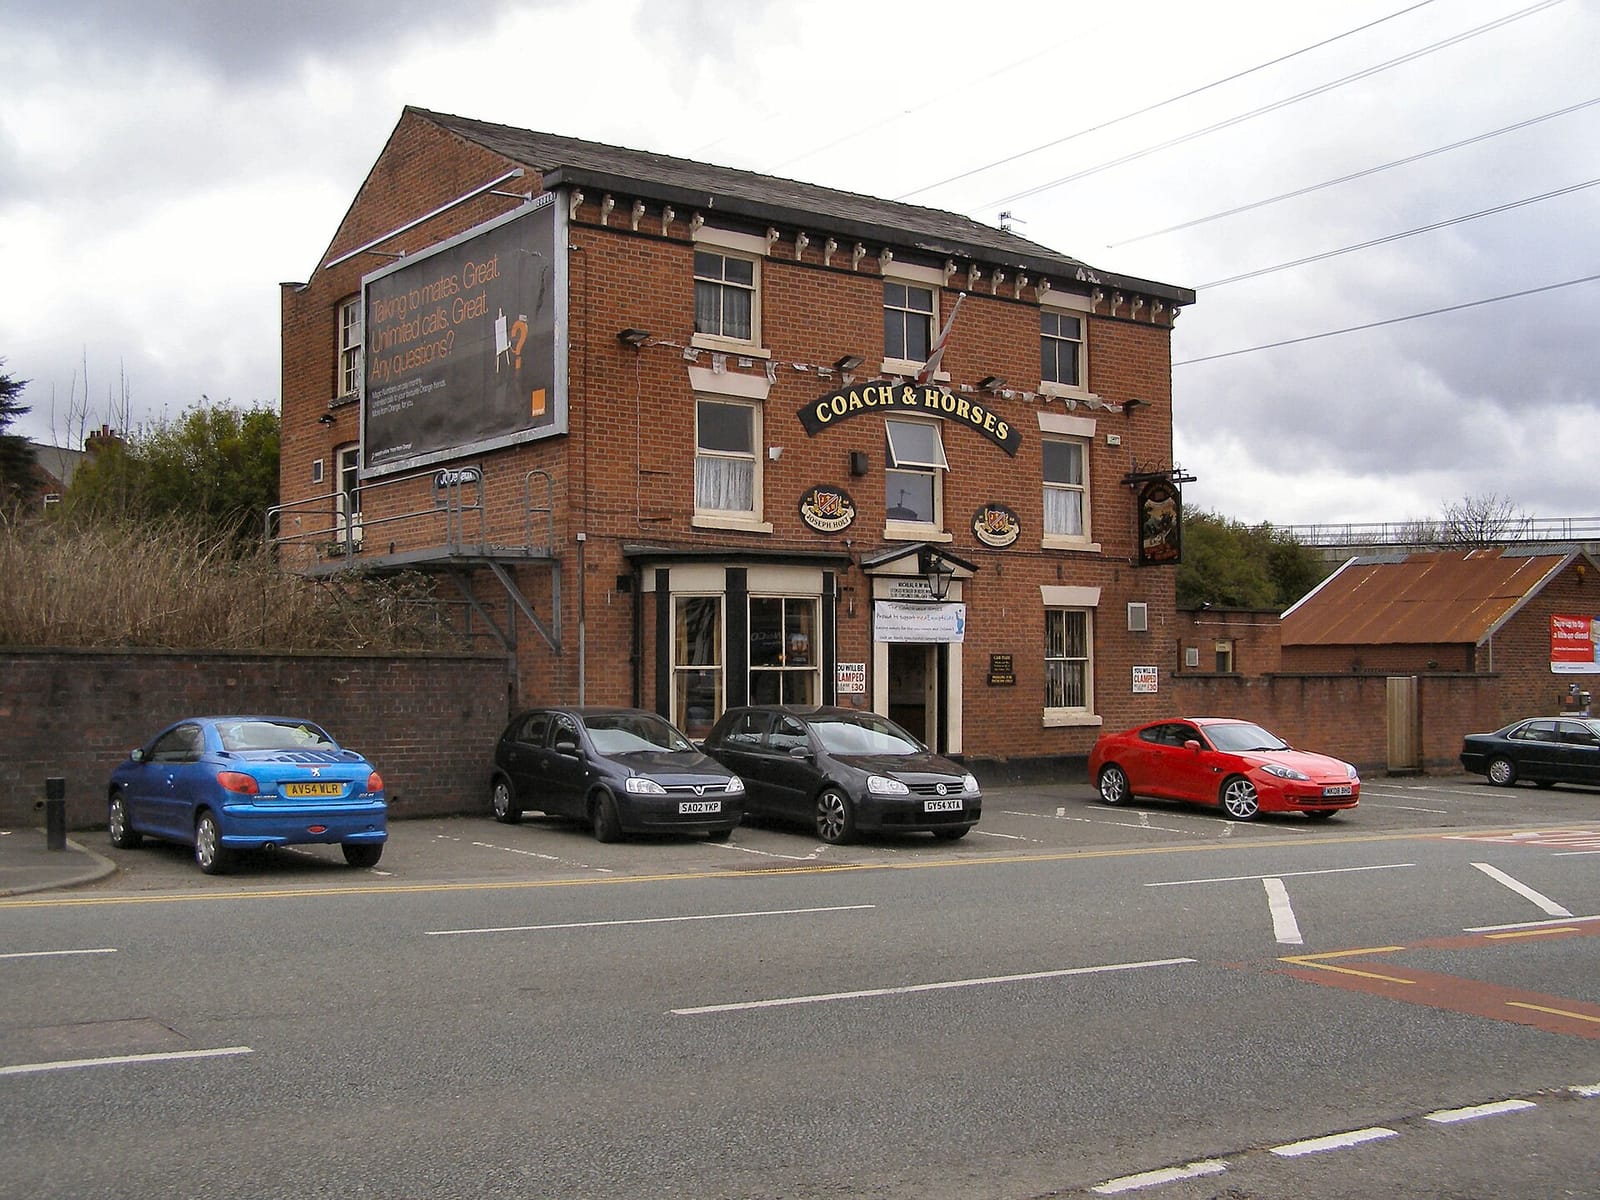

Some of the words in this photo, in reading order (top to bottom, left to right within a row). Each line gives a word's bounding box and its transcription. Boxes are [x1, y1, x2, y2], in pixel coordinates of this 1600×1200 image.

[373, 296, 406, 323] Talking
[409, 288, 419, 310] to
[422, 275, 460, 305] mates.
[463, 254, 500, 289] Great.
[372, 314, 419, 353] Unlimited
[422, 307, 449, 335] calls.
[452, 290, 489, 324] Great.
[371, 358, 392, 382] Any
[393, 330, 454, 375] questions?
[816, 386, 894, 423] COACH
[902, 386, 917, 405] &
[924, 389, 1009, 440] HORSES
[806, 514, 831, 529] JOSEPH
[833, 516, 849, 528] HOLT
[838, 672, 865, 682] LAMPED
[1134, 674, 1157, 683] CLAMPED
[851, 683, 864, 691] £30
[292, 784, 317, 794] AV54
[320, 784, 338, 793] WLR
[682, 803, 703, 812] SA02
[704, 803, 719, 812] YKP
[927, 801, 946, 810] GY54
[947, 801, 961, 809] XTA
